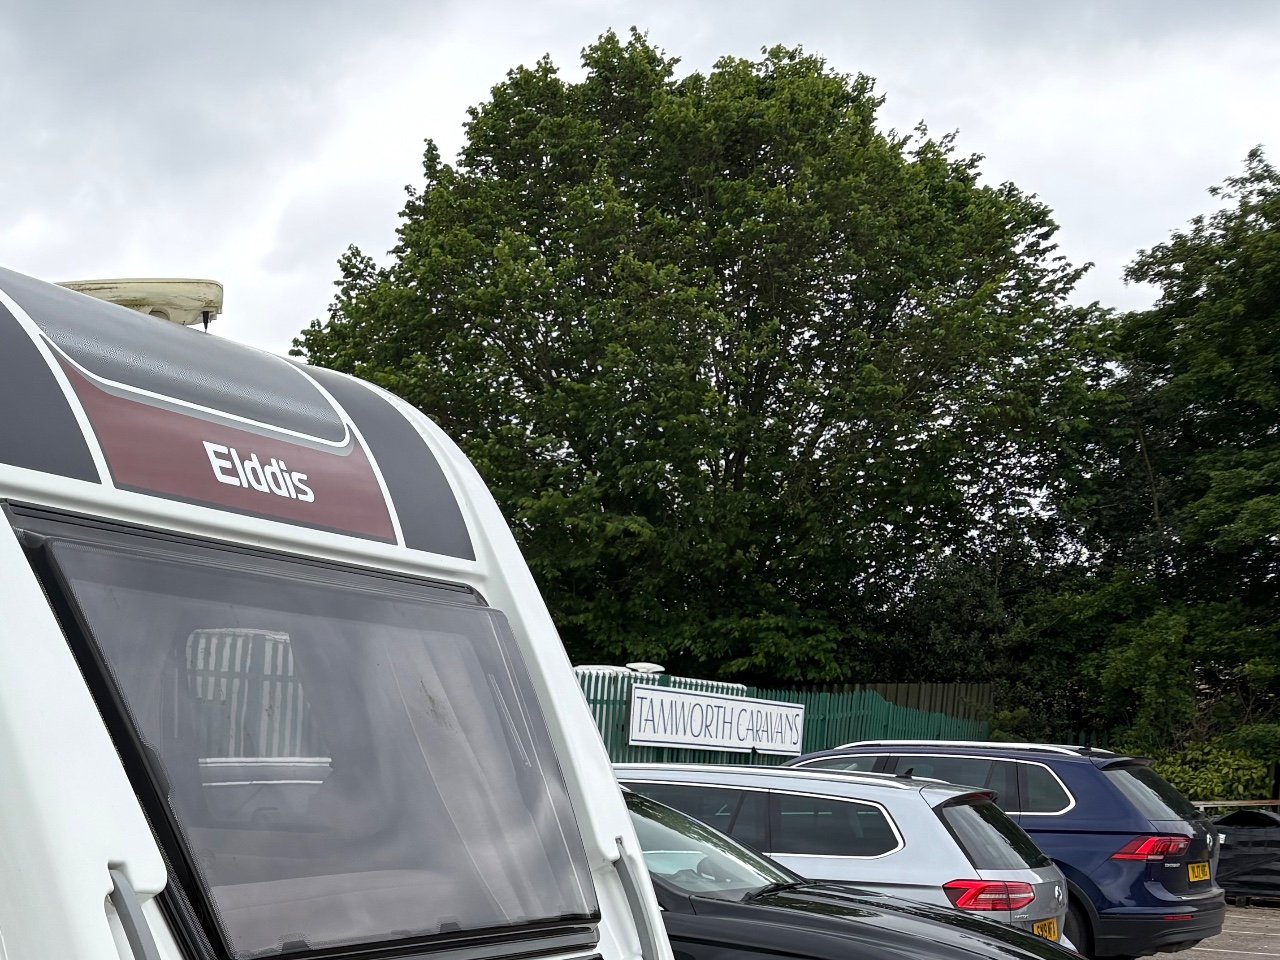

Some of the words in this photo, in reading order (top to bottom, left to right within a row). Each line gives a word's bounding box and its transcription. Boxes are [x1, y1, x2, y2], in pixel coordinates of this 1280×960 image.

[202, 440, 315, 503] Elddis
[636, 696, 734, 741] TAMWORTH
[736, 708, 800, 745] CARAVANS
